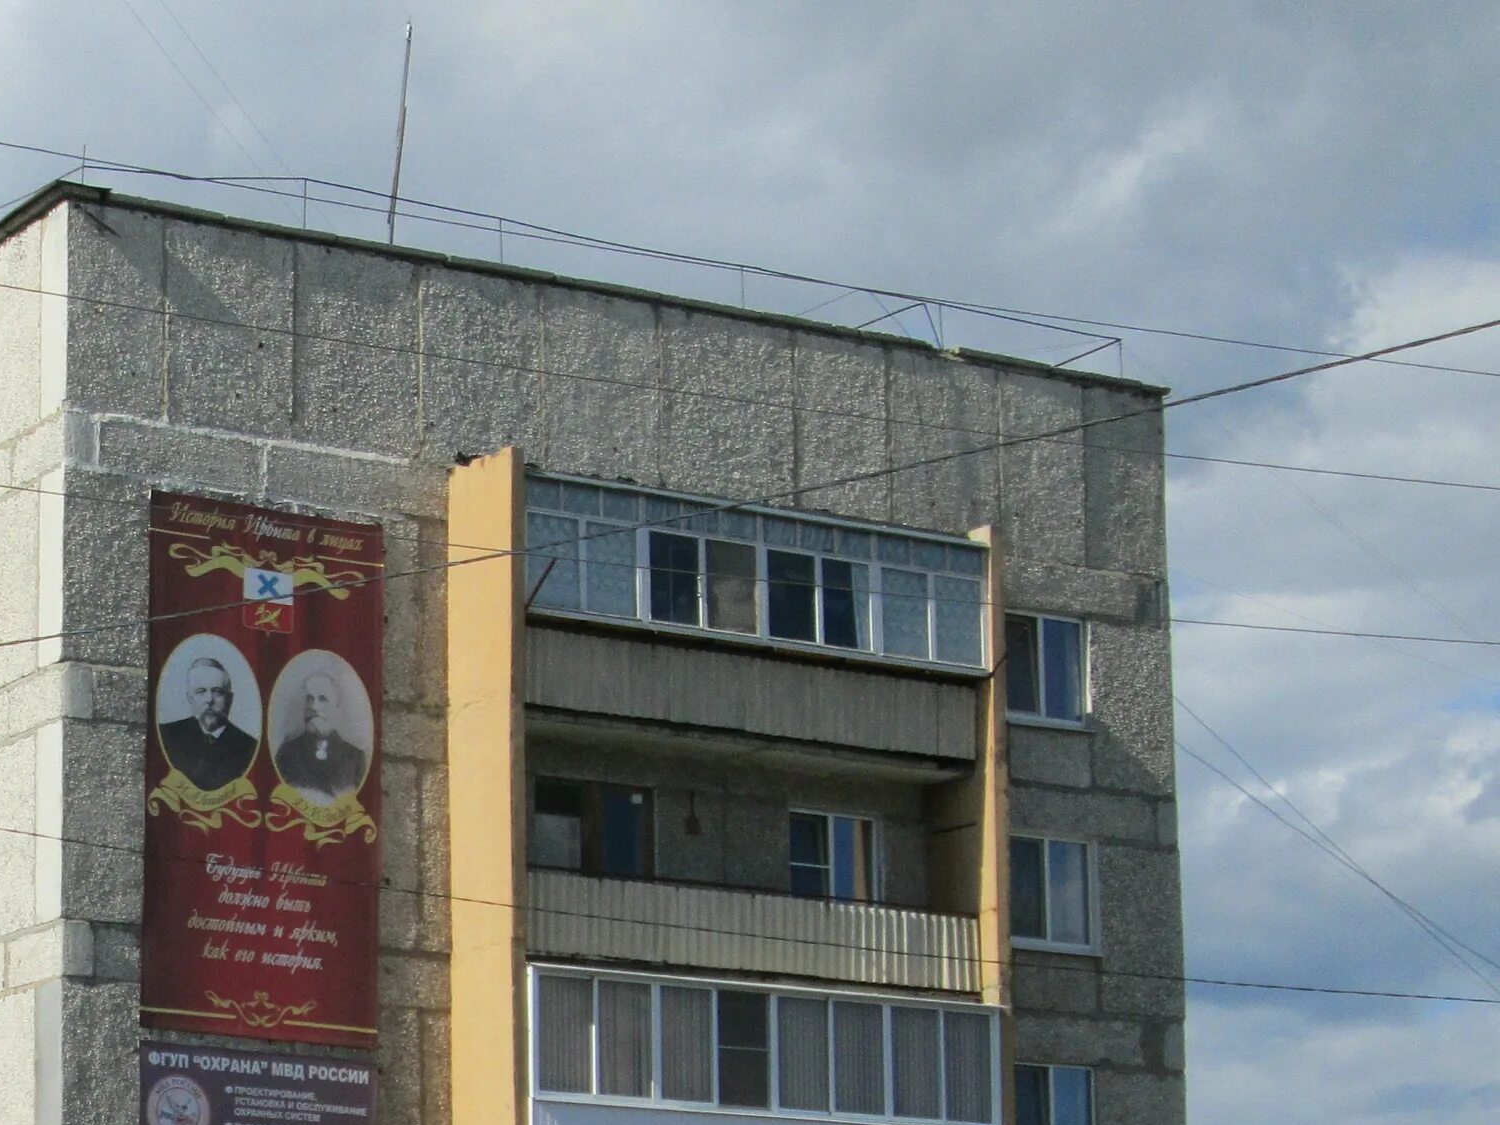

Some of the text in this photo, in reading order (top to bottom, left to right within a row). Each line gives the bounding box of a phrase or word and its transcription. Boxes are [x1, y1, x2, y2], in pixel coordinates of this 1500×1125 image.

[218, 884, 312, 913] должно быть
[273, 925, 283, 937] и
[202, 937, 230, 961] как
[148, 1051, 189, 1068] ФГУП
[271, 1063, 305, 1081] МВД
[309, 1066, 369, 1085] РОССИИ
[234, 1108, 320, 1122] ОХРАННЫХ СИСТЕМ
[288, 1101, 294, 1110] И
